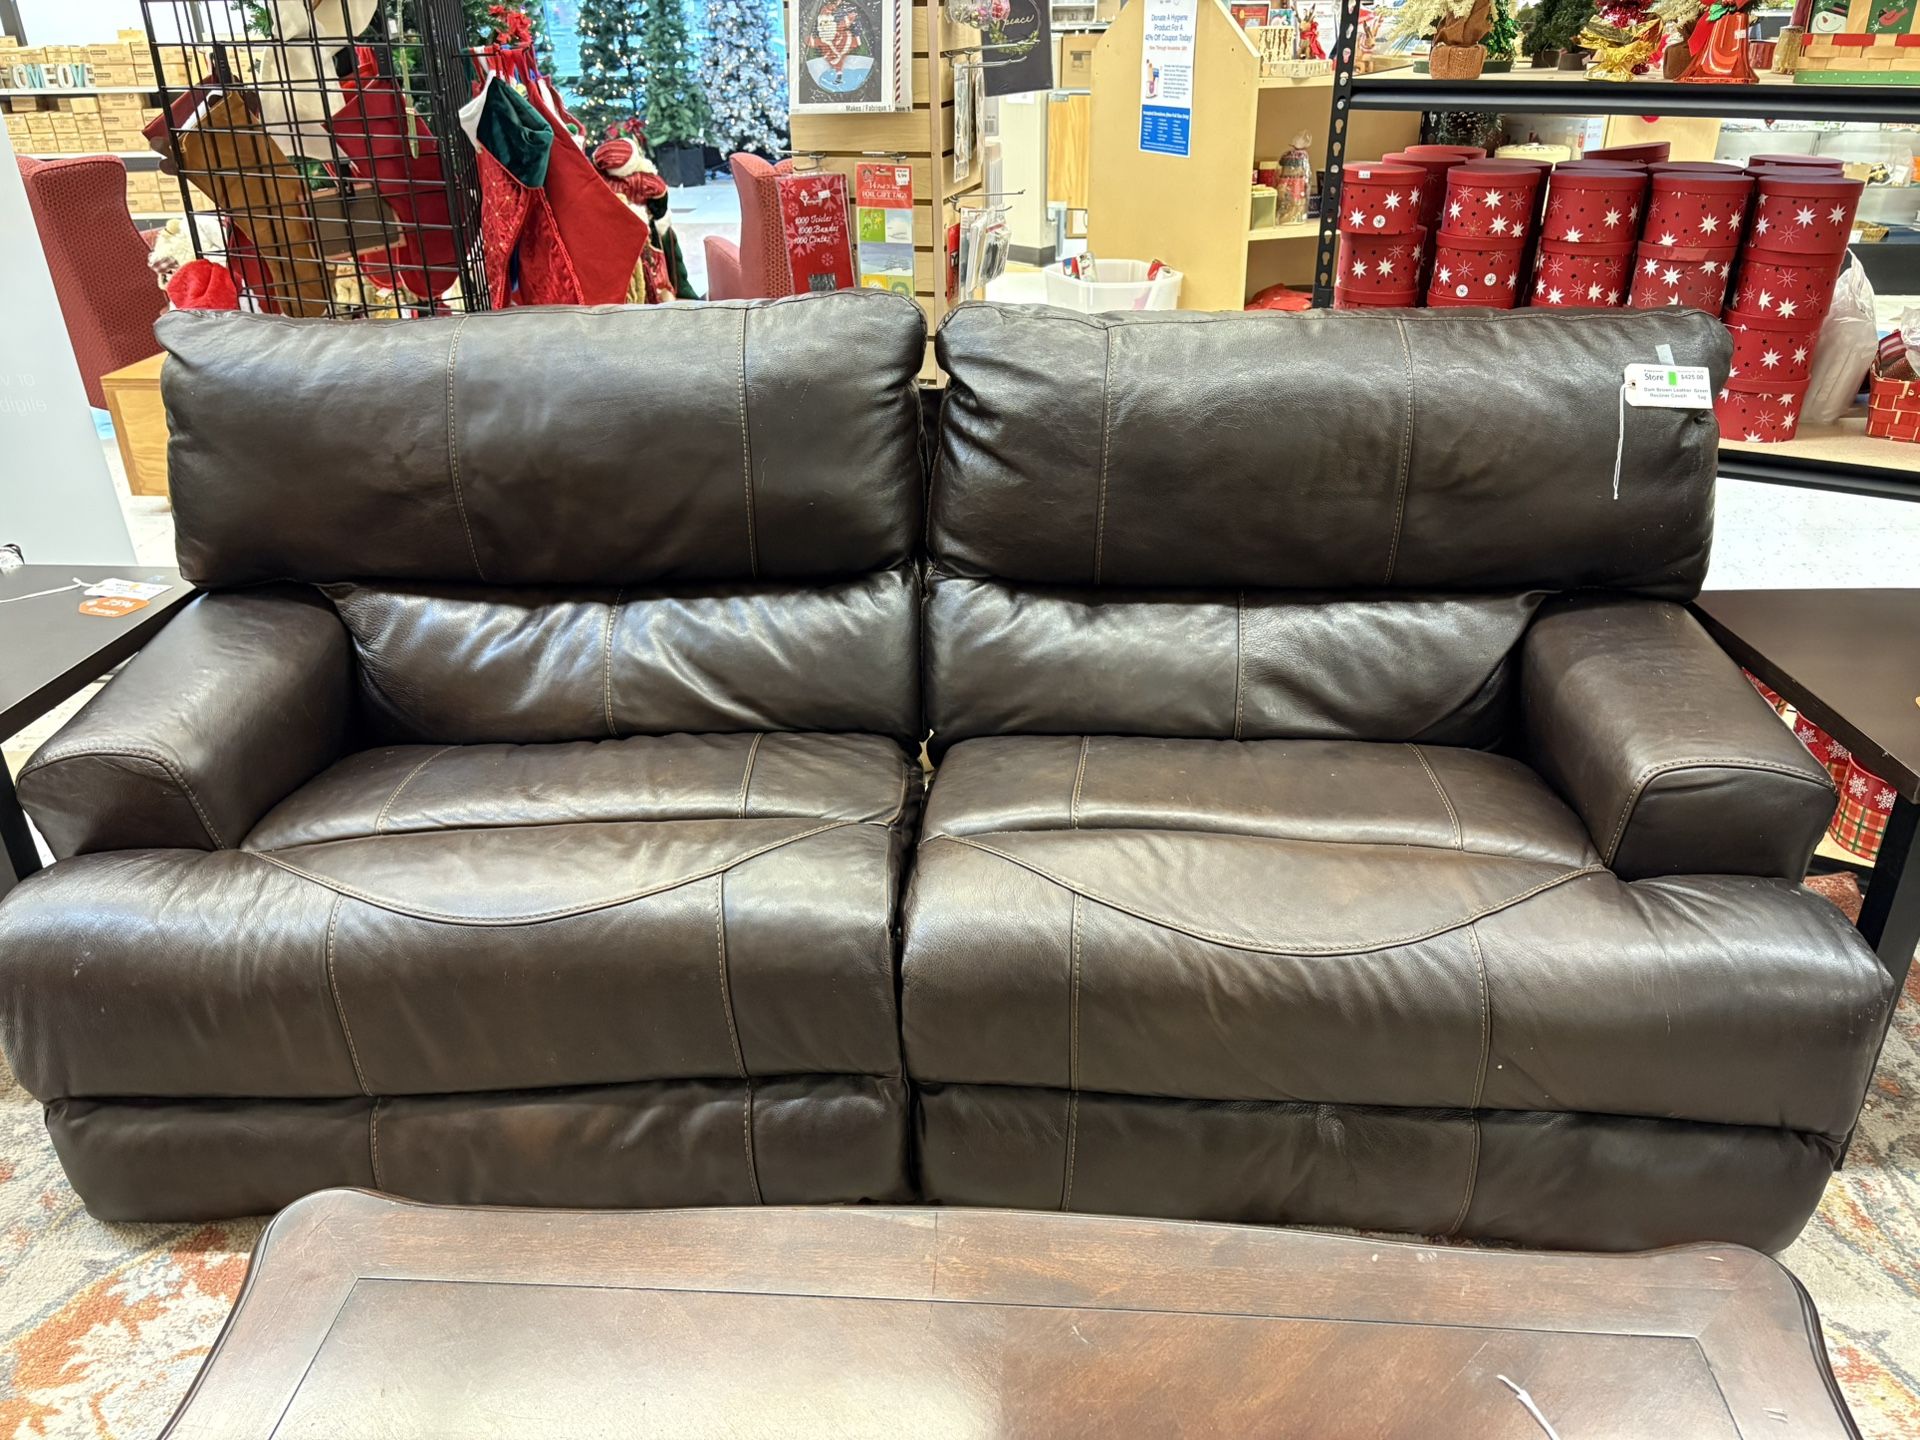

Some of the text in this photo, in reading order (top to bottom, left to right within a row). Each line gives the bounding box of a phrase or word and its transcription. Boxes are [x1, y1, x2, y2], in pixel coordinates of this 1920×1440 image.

[1002, 14, 1035, 31] peace
[795, 216, 810, 225] 1000
[798, 226, 813, 235] 1000
[1644, 373, 1664, 381] Store
